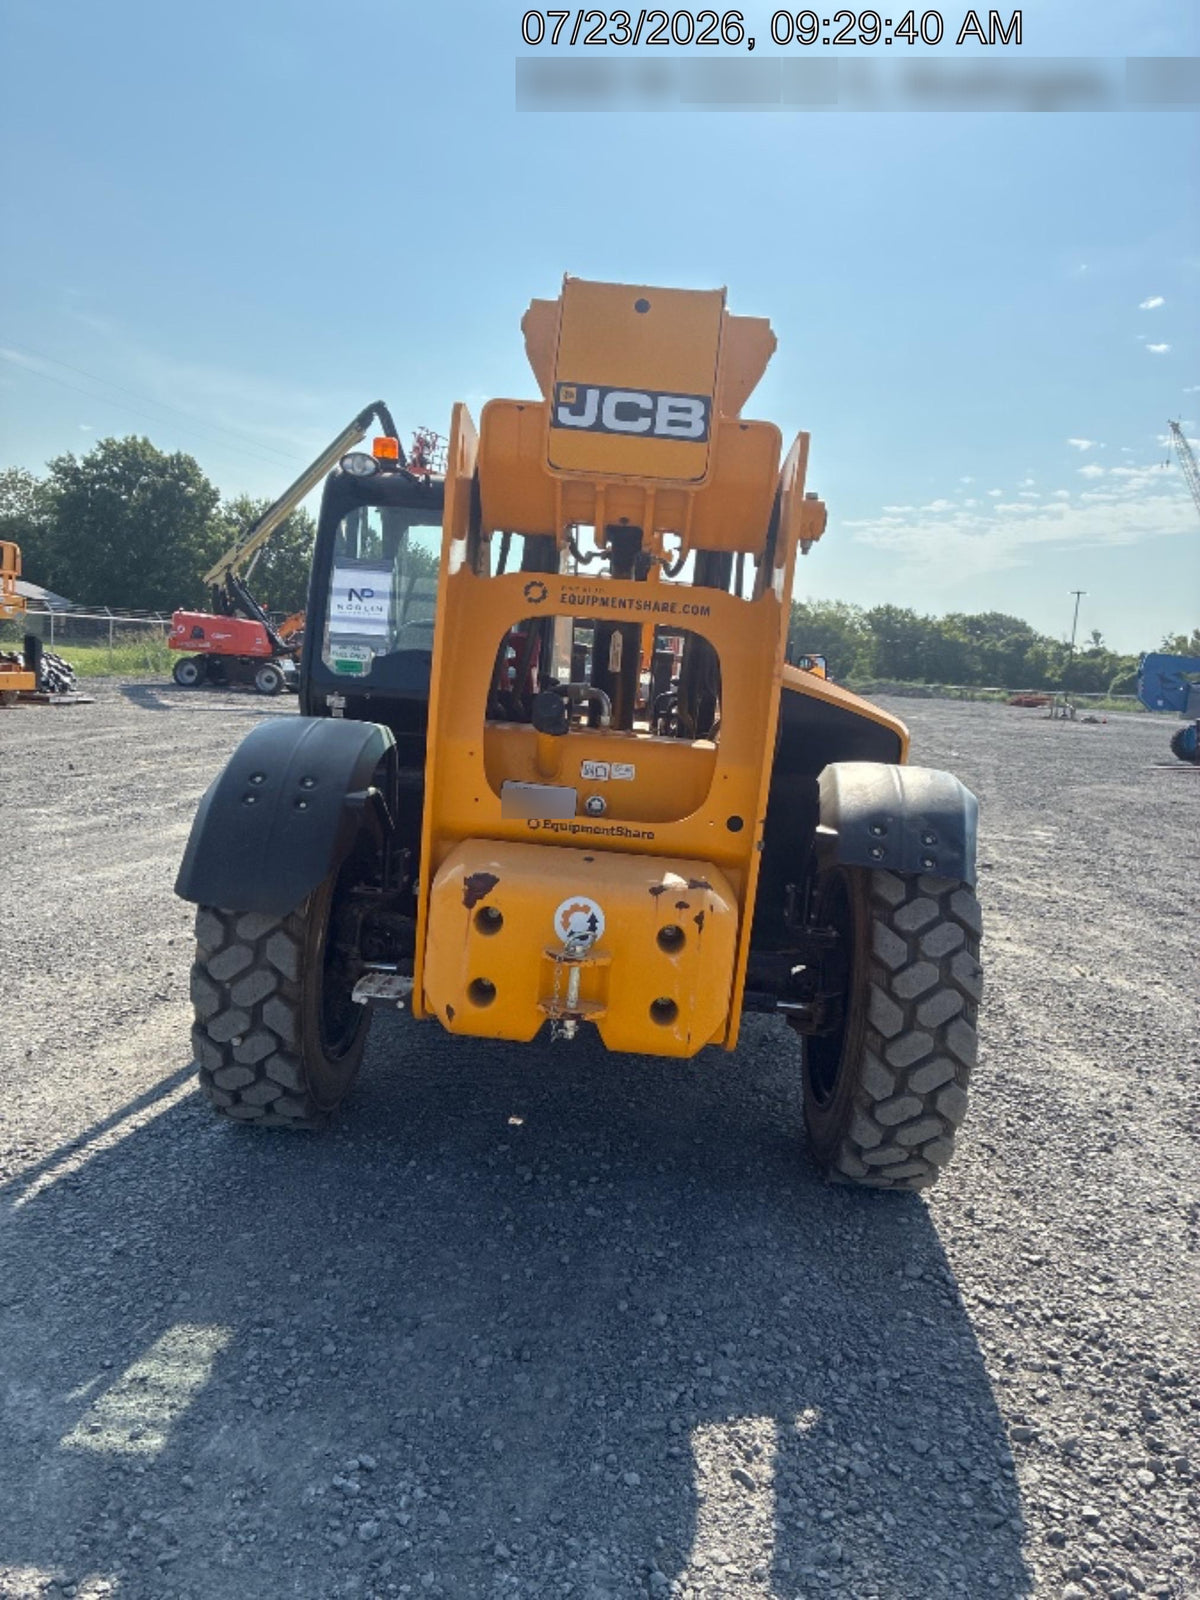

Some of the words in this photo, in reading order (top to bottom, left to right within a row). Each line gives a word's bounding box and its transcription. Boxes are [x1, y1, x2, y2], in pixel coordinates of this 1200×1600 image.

[558, 388, 705, 438] JCB
[560, 592, 711, 617] EQUIPMENTSHARE.COM
[543, 819, 655, 840] EquipmentShare
